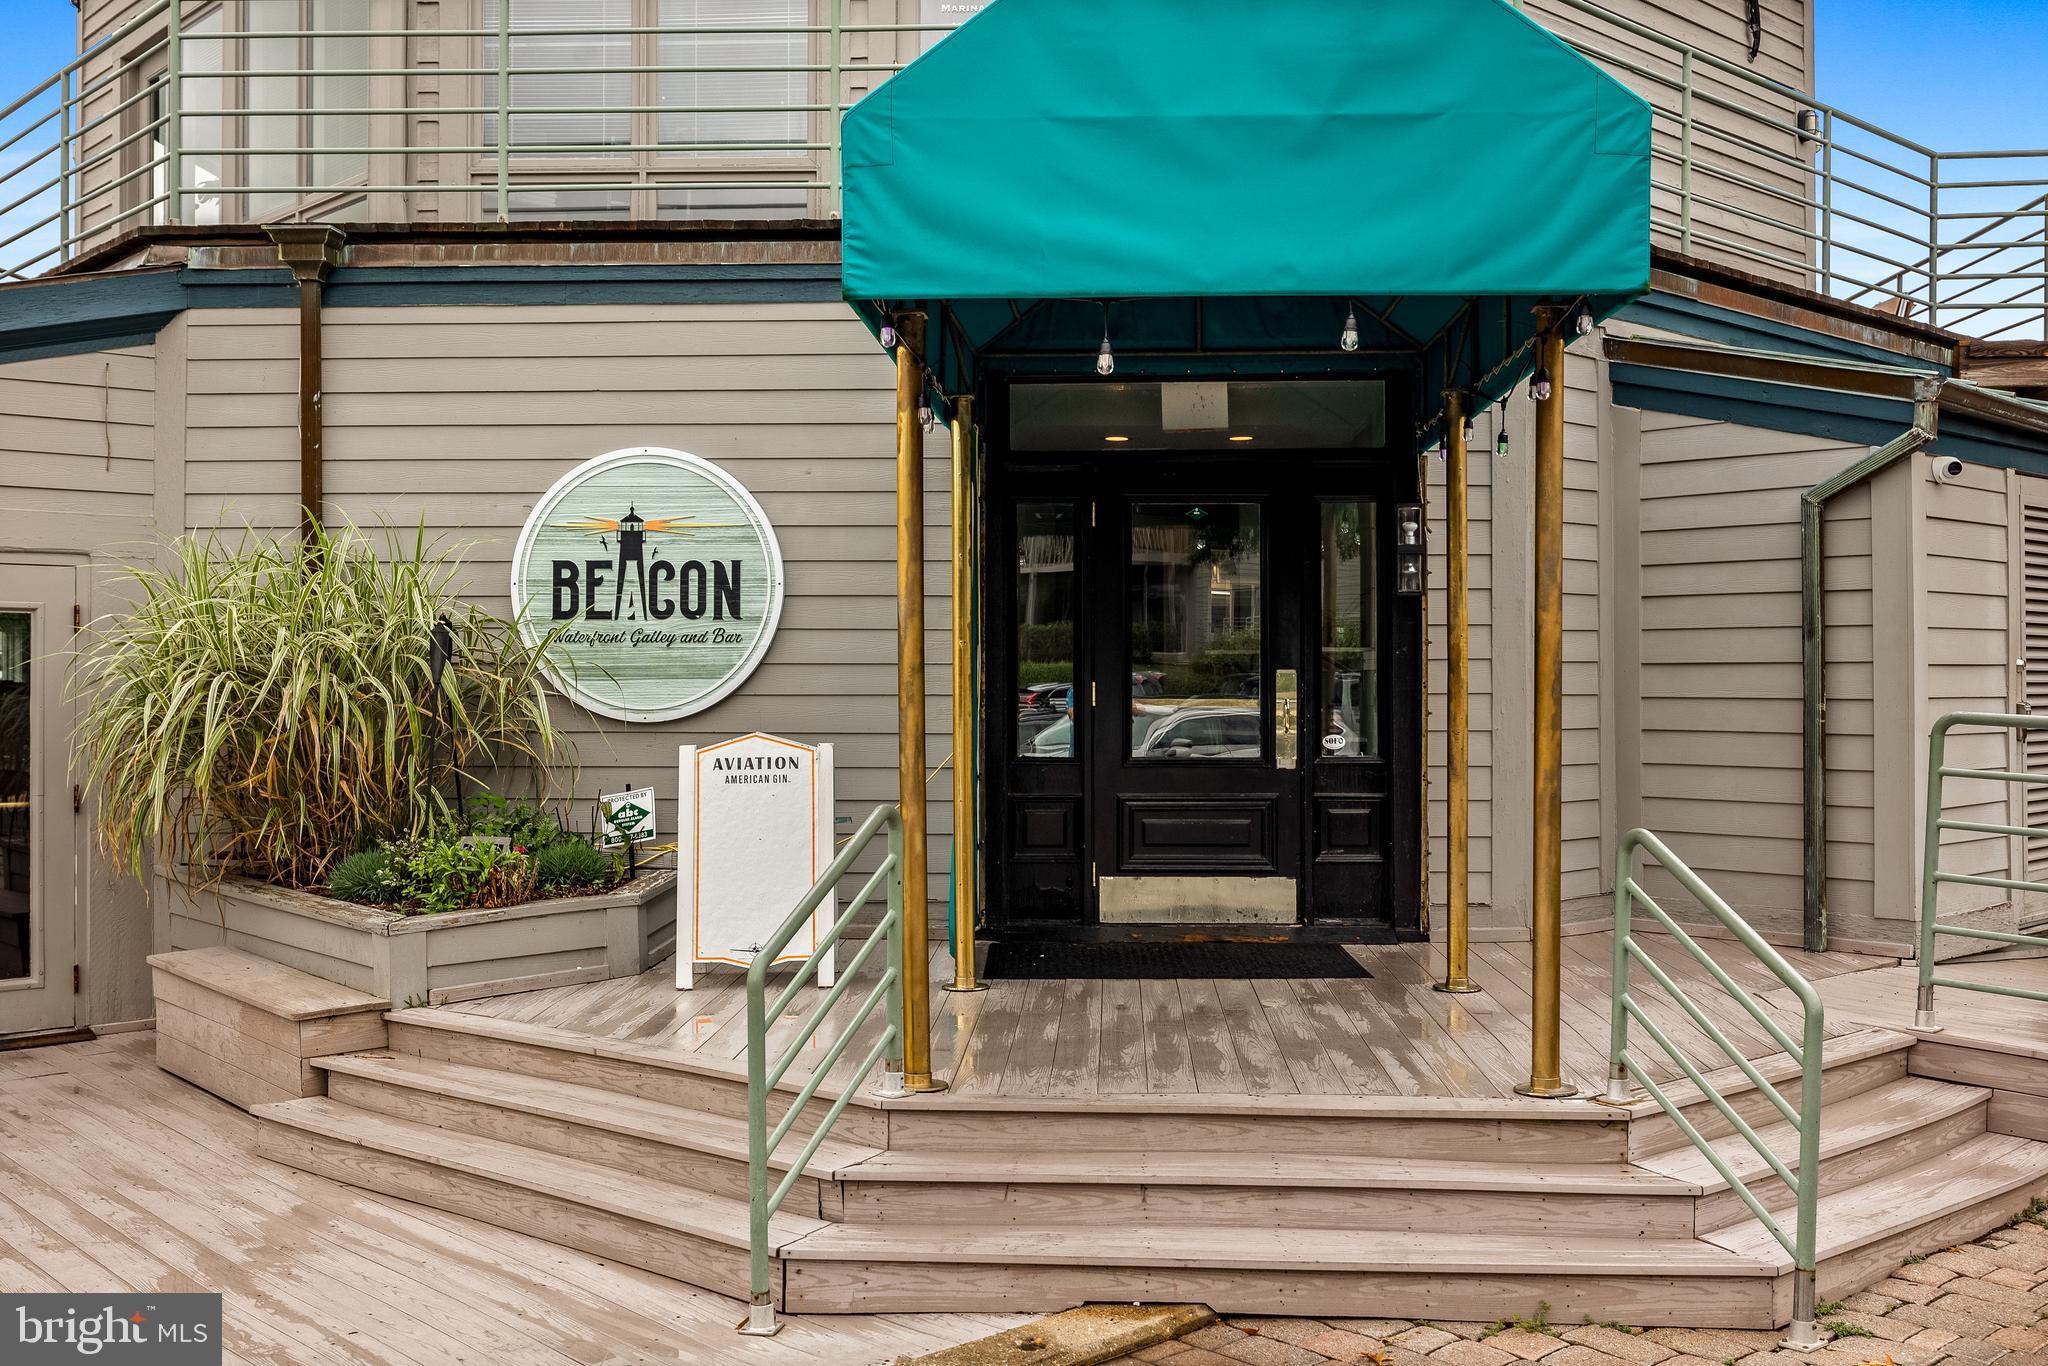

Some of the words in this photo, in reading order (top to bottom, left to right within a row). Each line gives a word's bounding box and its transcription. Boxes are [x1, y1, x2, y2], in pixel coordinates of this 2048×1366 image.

[941, 4, 984, 12] MARINA
[551, 556, 743, 621] BEACON
[630, 628, 677, 647] Galley
[680, 630, 708, 644] and
[712, 627, 742, 644] Bar
[712, 756, 799, 771] AVIATION
[724, 774, 770, 784] AMERICAN
